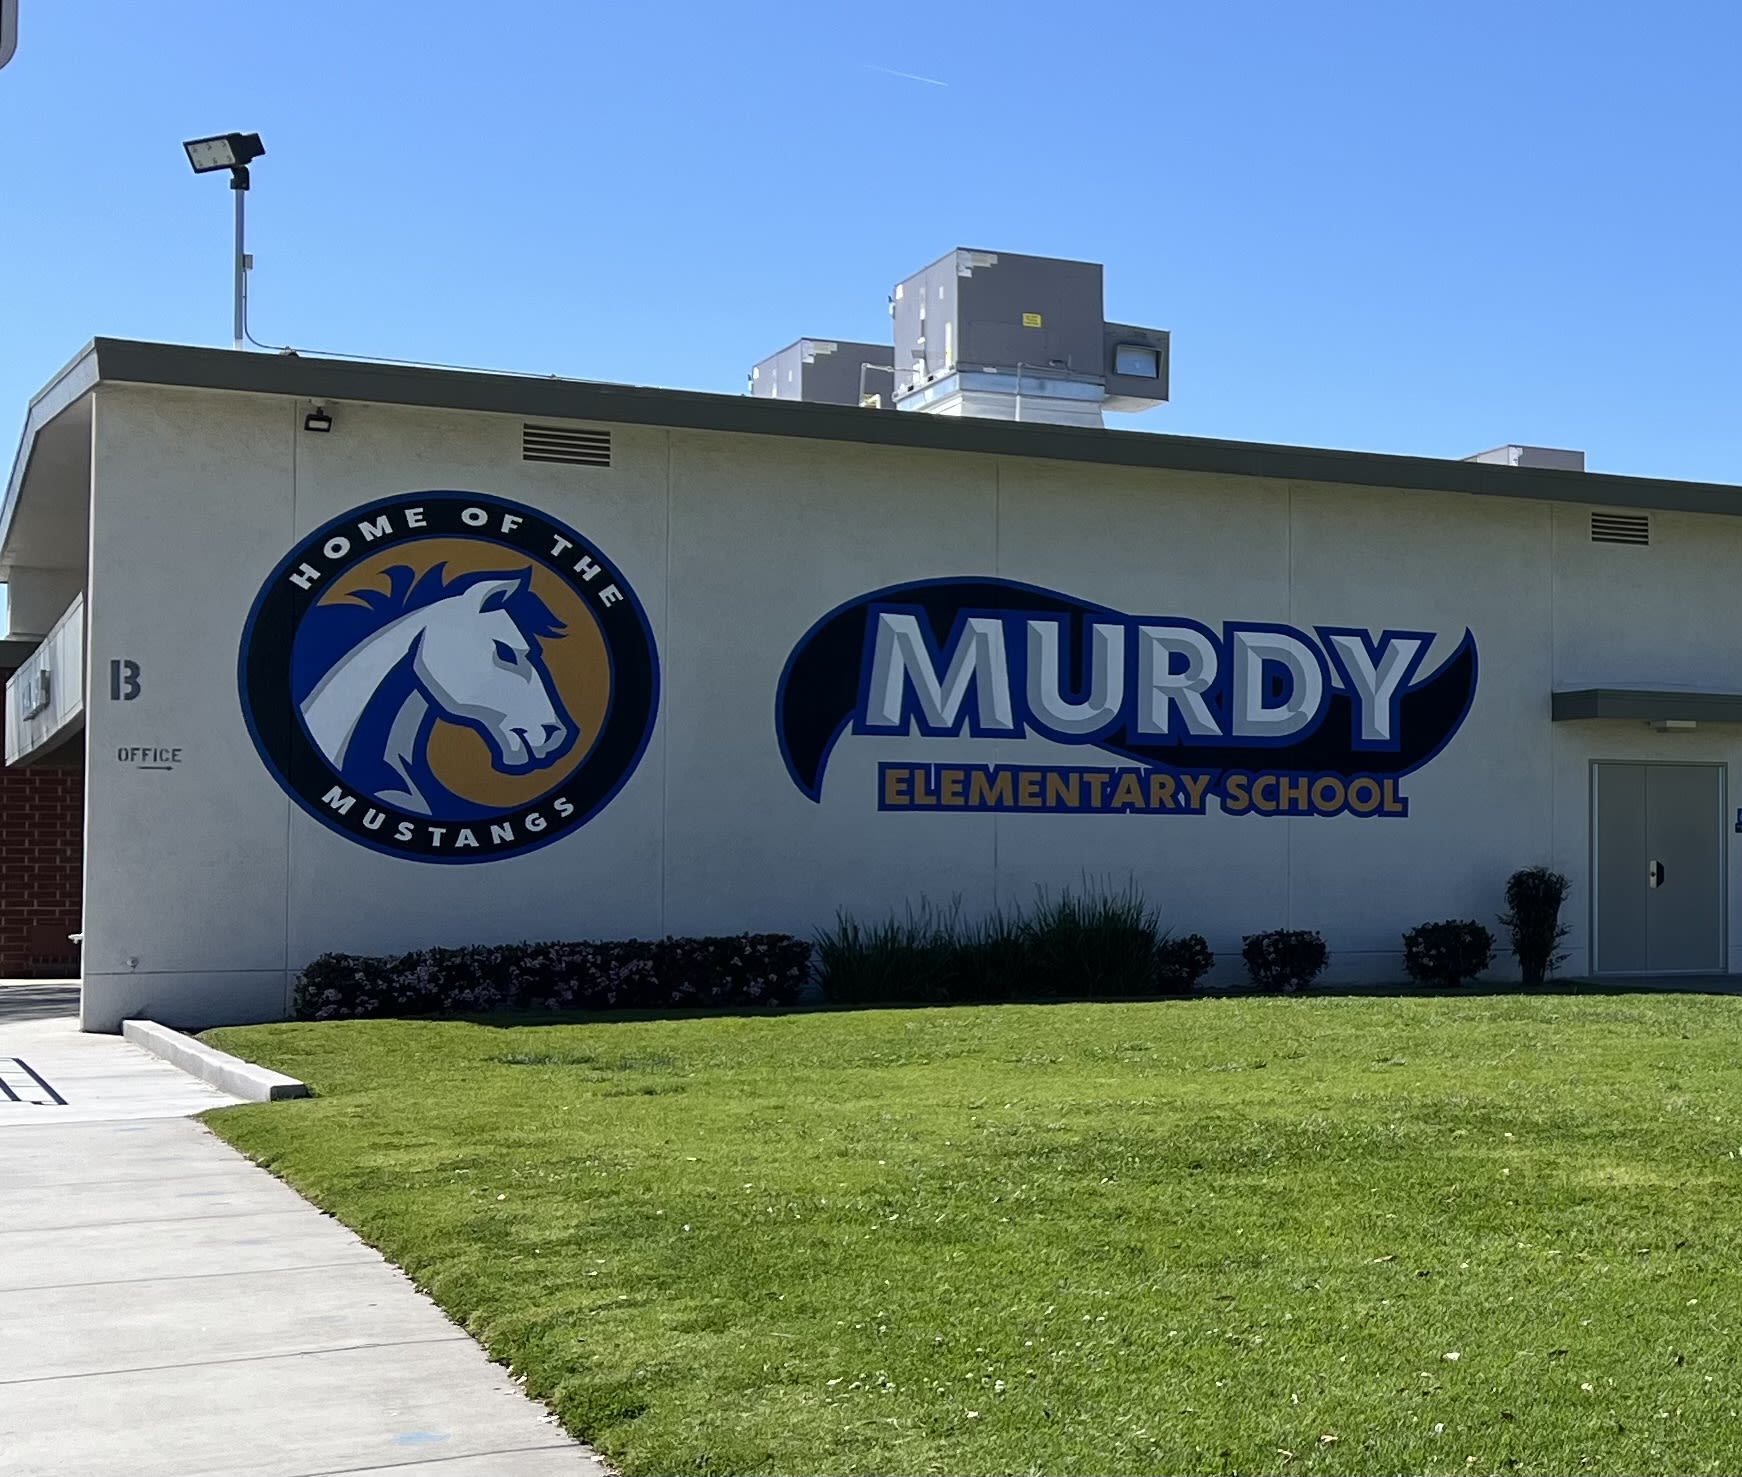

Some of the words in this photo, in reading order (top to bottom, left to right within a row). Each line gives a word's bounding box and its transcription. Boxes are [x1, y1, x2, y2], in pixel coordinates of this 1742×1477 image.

[289, 507, 427, 590] HOME
[460, 507, 523, 534] OF
[549, 534, 624, 608] THE
[110, 659, 141, 700] B
[862, 609, 1424, 744] MURDY
[118, 747, 182, 762] OFFICE
[321, 785, 574, 847] MUSTANGS
[884, 767, 1211, 811] ELEMENTARY
[1225, 773, 1404, 813] SCHOOL
